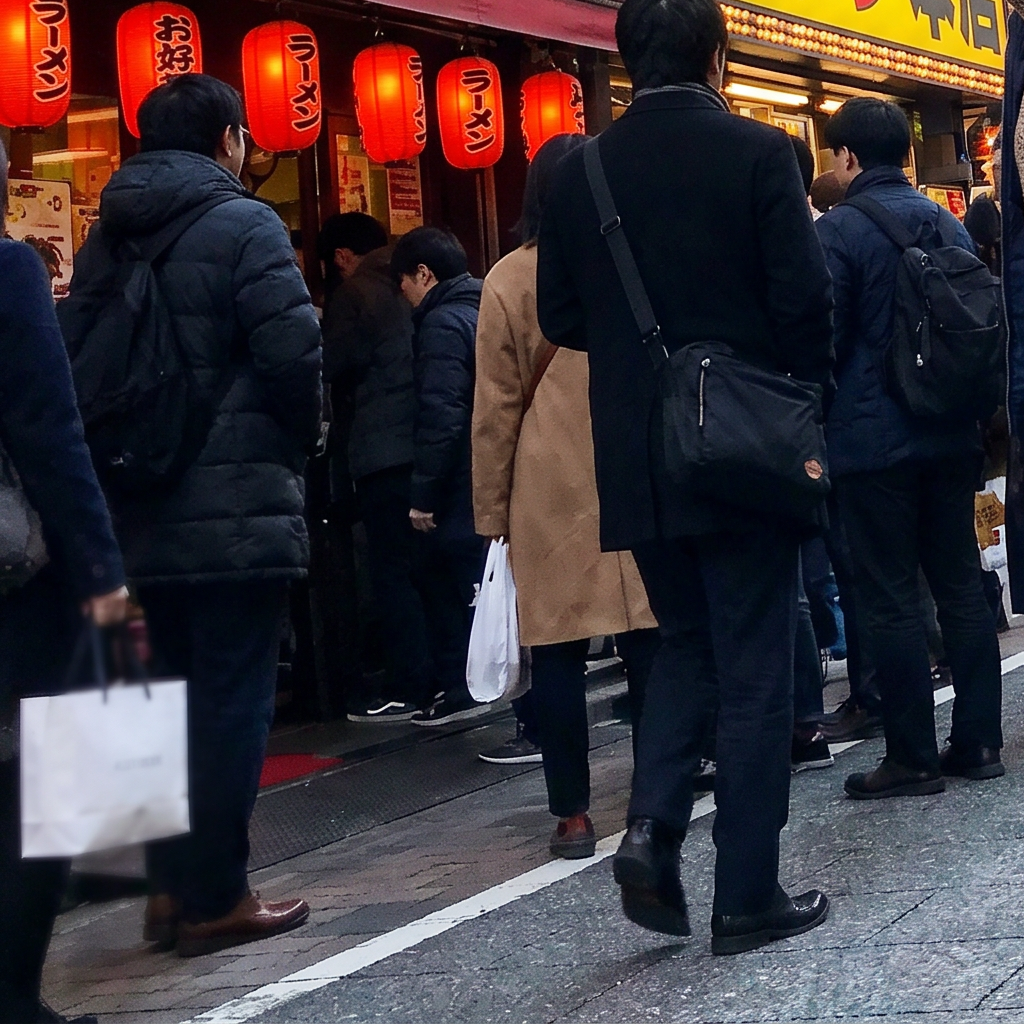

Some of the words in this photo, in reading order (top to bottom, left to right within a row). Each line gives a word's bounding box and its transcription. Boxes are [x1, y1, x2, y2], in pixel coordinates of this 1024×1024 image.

[153, 14, 195, 86] お好
[285, 34, 321, 132] ラーメン
[461, 68, 495, 154] ラーメン
